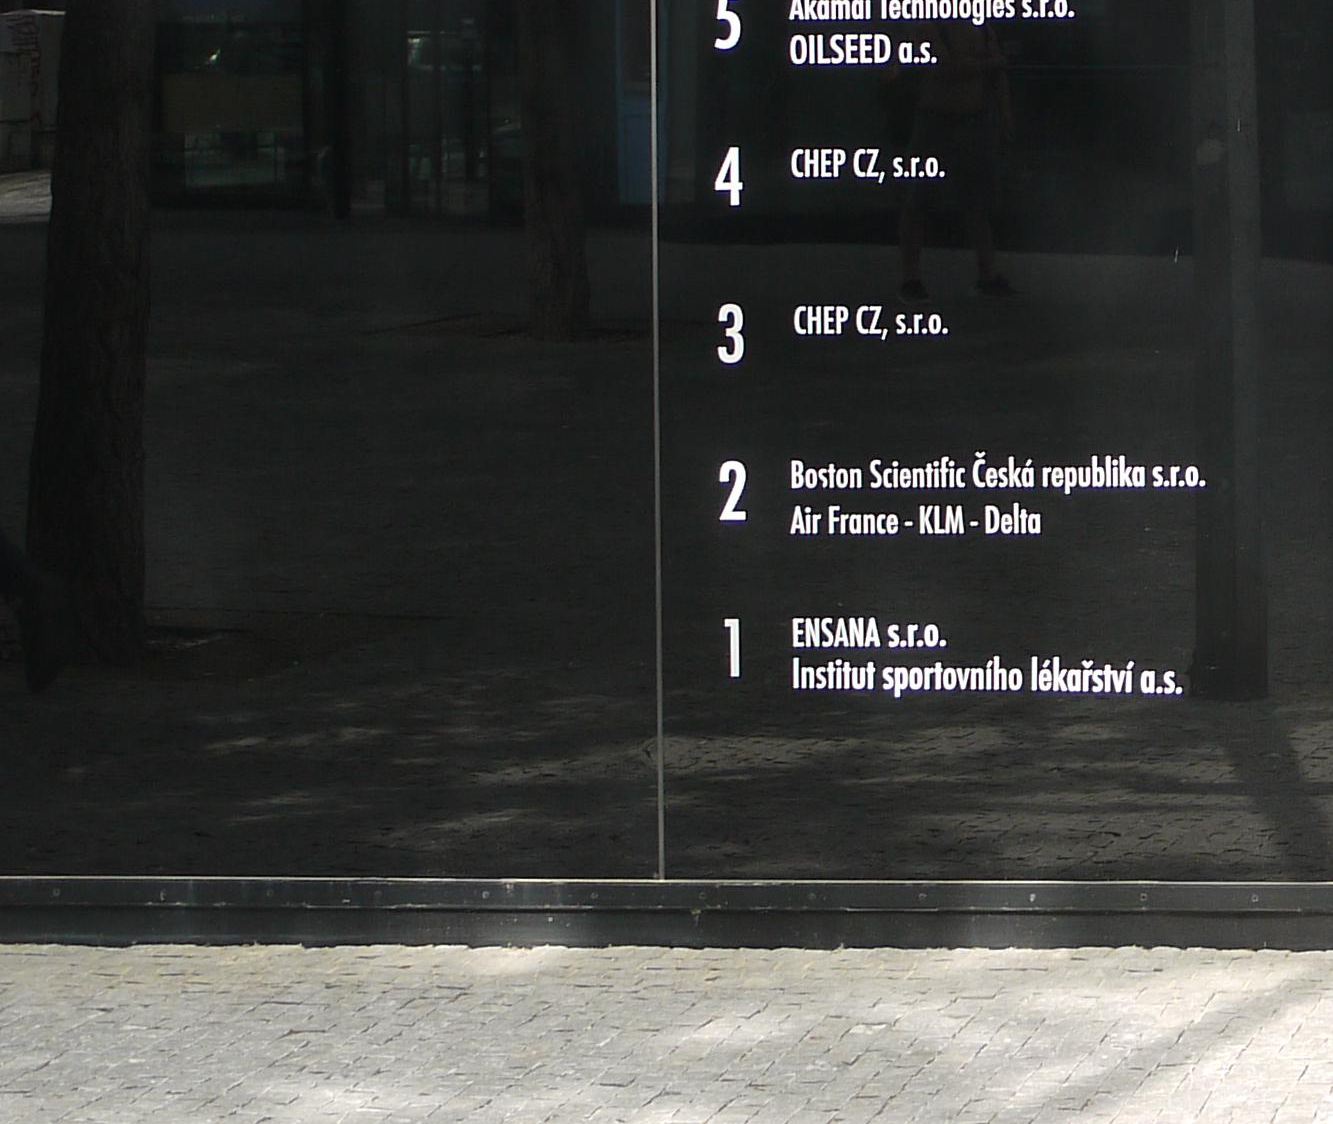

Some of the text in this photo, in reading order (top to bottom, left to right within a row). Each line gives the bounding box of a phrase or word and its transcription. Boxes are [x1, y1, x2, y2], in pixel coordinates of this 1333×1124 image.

[789, 33, 938, 65] OILSEED a.s.
[714, 146, 946, 207] 4 CHEP CZ, s.r.o.
[717, 303, 949, 364] 3 CHEP CZ, s.r.o.
[718, 451, 1207, 521] 2 Boston Scientific Česká republika s.r.o.
[789, 505, 822, 535] Air
[828, 505, 899, 535] France
[919, 504, 965, 535] KLM
[984, 502, 1042, 535] Delta
[723, 616, 947, 678] 1 ENSANA s.r.o.
[792, 655, 1183, 699] Institut sportovního lékařství a.s.
